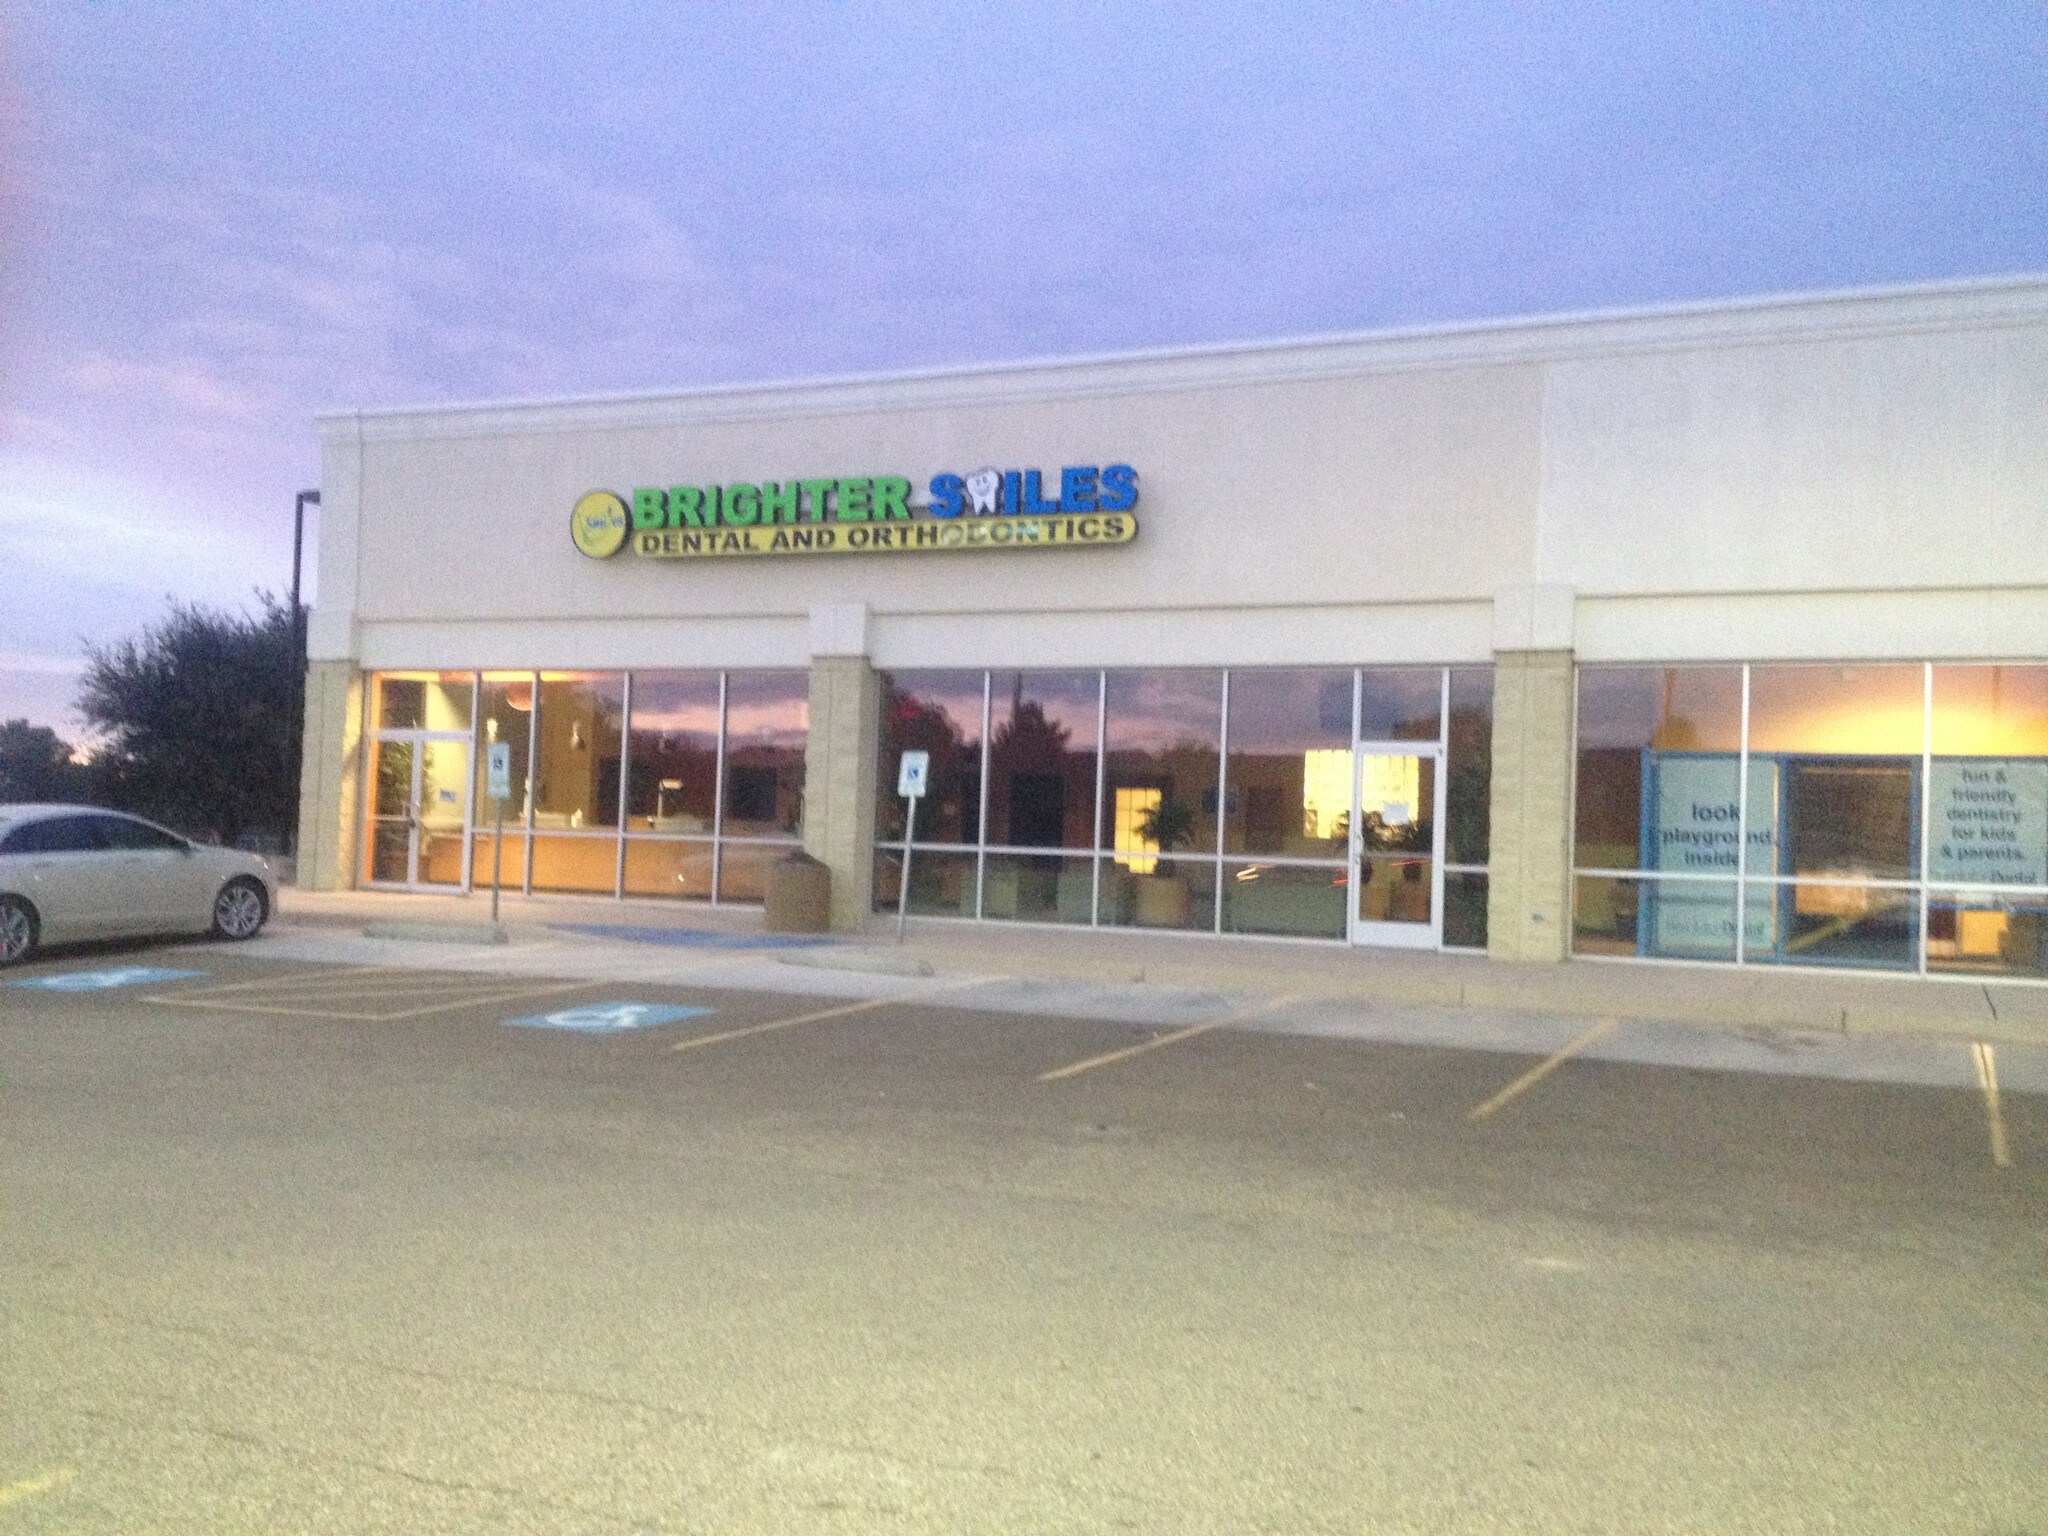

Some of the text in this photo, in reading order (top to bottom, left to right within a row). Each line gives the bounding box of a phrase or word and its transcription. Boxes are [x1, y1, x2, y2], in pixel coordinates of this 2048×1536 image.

[632, 476, 913, 529] BRIGHTER
[641, 516, 1125, 554] DENTAL AND ORTHODONTICS
[1961, 768, 1989, 783] fun
[1952, 789, 2015, 806] friendly
[1691, 802, 1740, 820] look
[1946, 808, 2021, 823] dentistry
[1662, 829, 1771, 846] playground
[1952, 826, 2017, 841] for kids
[1684, 850, 1740, 867] inside
